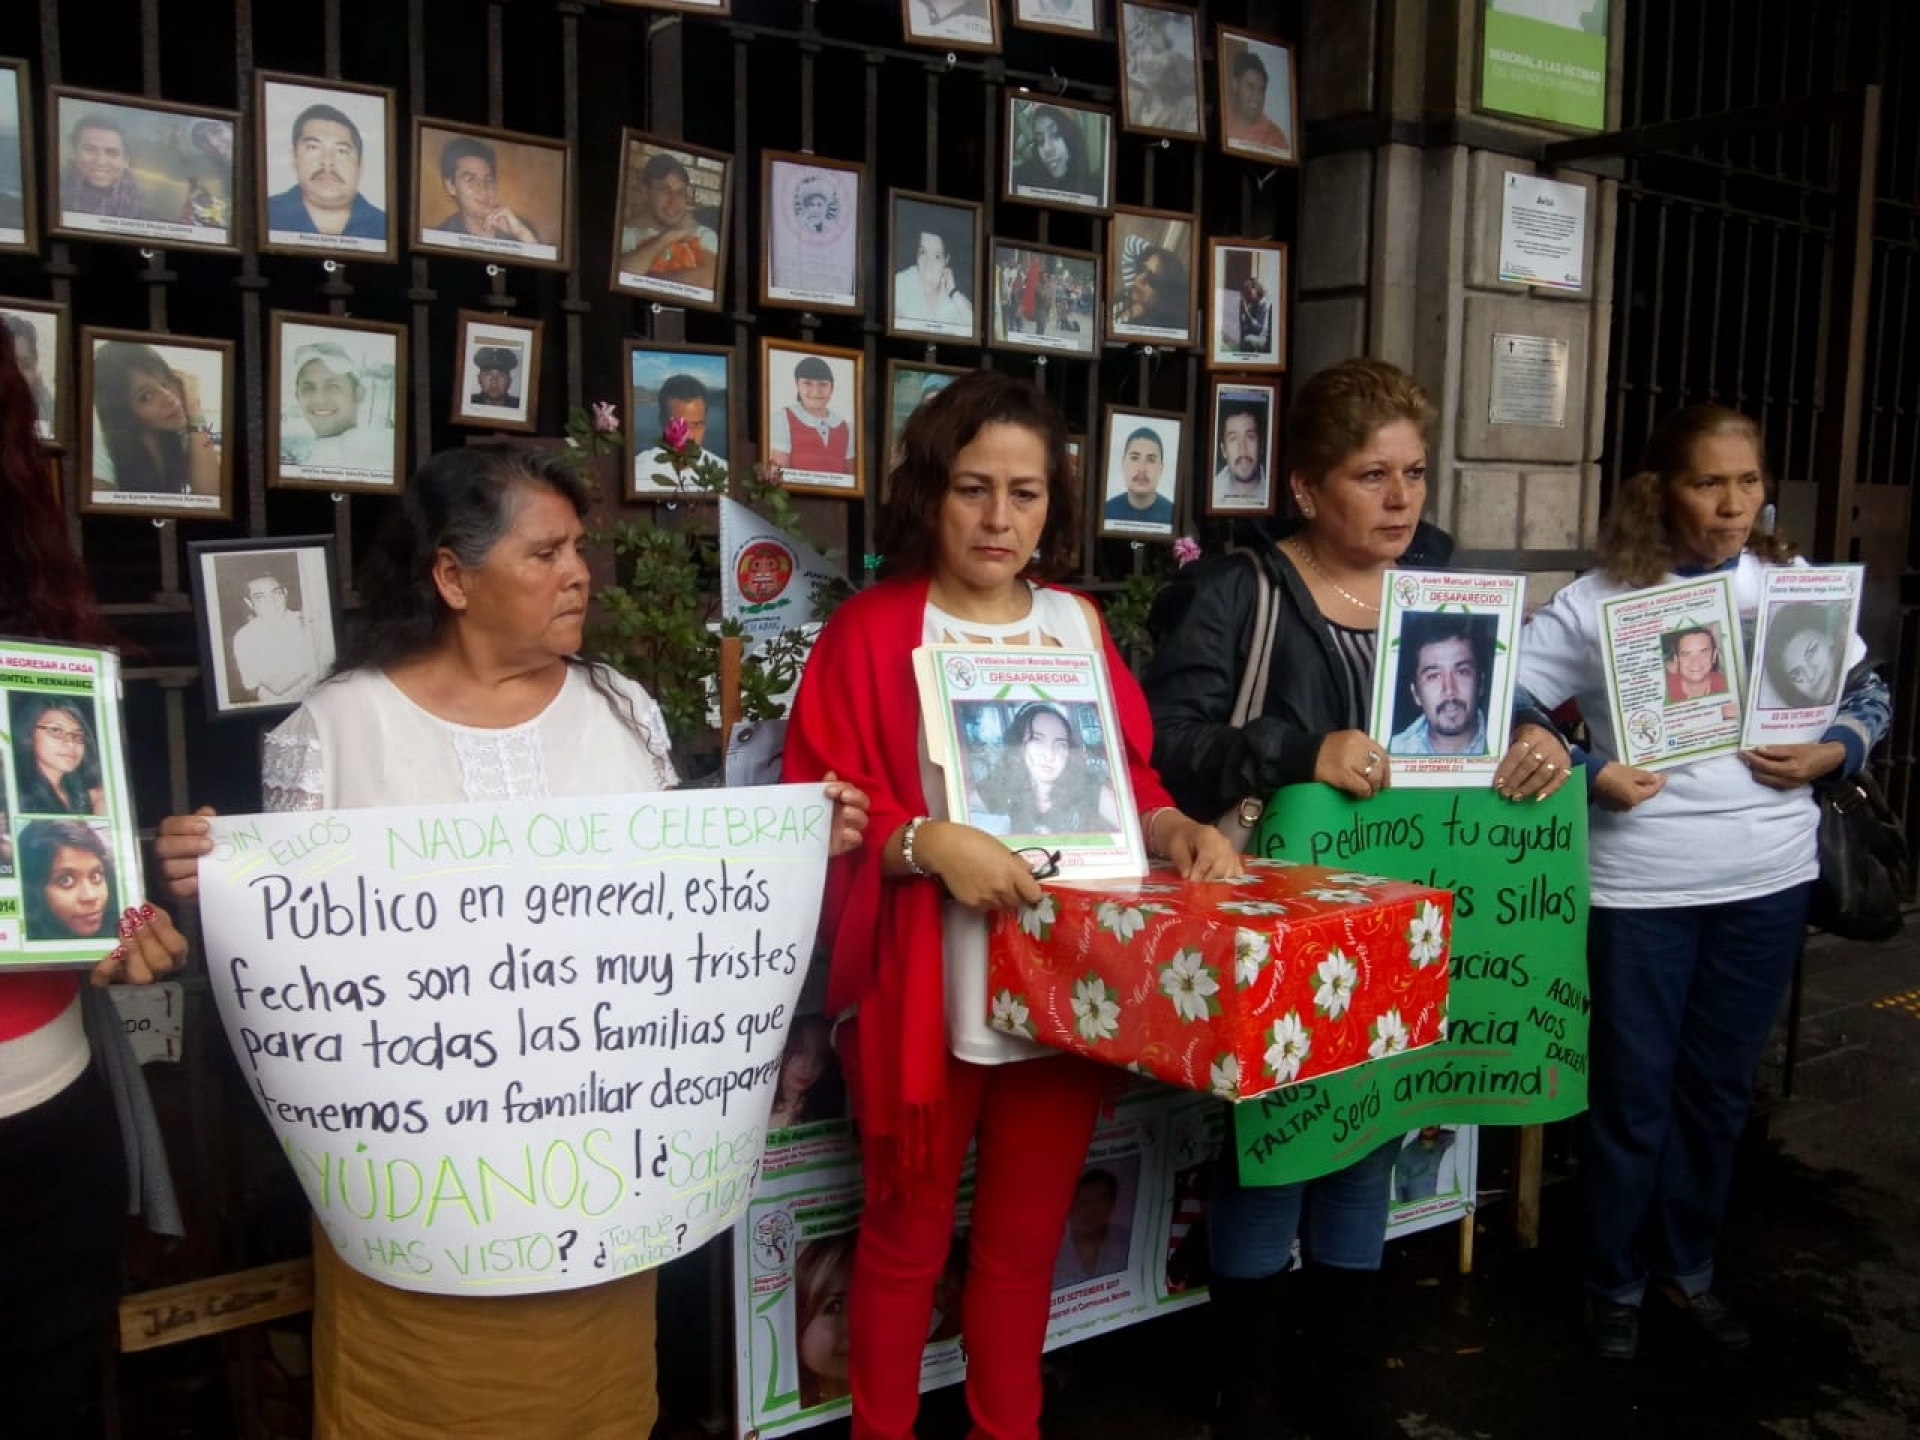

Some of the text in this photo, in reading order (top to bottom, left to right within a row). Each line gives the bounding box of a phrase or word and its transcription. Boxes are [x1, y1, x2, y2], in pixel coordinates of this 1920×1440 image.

[1430, 591, 1502, 604] DESAPARECIDO
[69, 662, 94, 673] CASA
[989, 671, 1080, 683] DESAPARECIDA
[268, 817, 350, 866] ELLOS
[388, 806, 824, 869] NADA QUE CELEBRAR
[1310, 810, 1424, 865] pedimos
[1442, 795, 1480, 847] tu
[1488, 816, 1573, 863] ayuda
[460, 885, 504, 921] en
[685, 859, 770, 914] estás
[1496, 873, 1577, 924] sillas
[230, 929, 797, 1014] fechas son días muy tristes
[243, 1001, 785, 1071] para todas las familias que
[1526, 1005, 1566, 1040] NOS
[256, 1078, 429, 1134] tenemos
[445, 1095, 489, 1125] un
[502, 1070, 644, 1125] familiar
[1244, 1087, 1330, 1164] FALTAN
[363, 1236, 433, 1276] HAS
